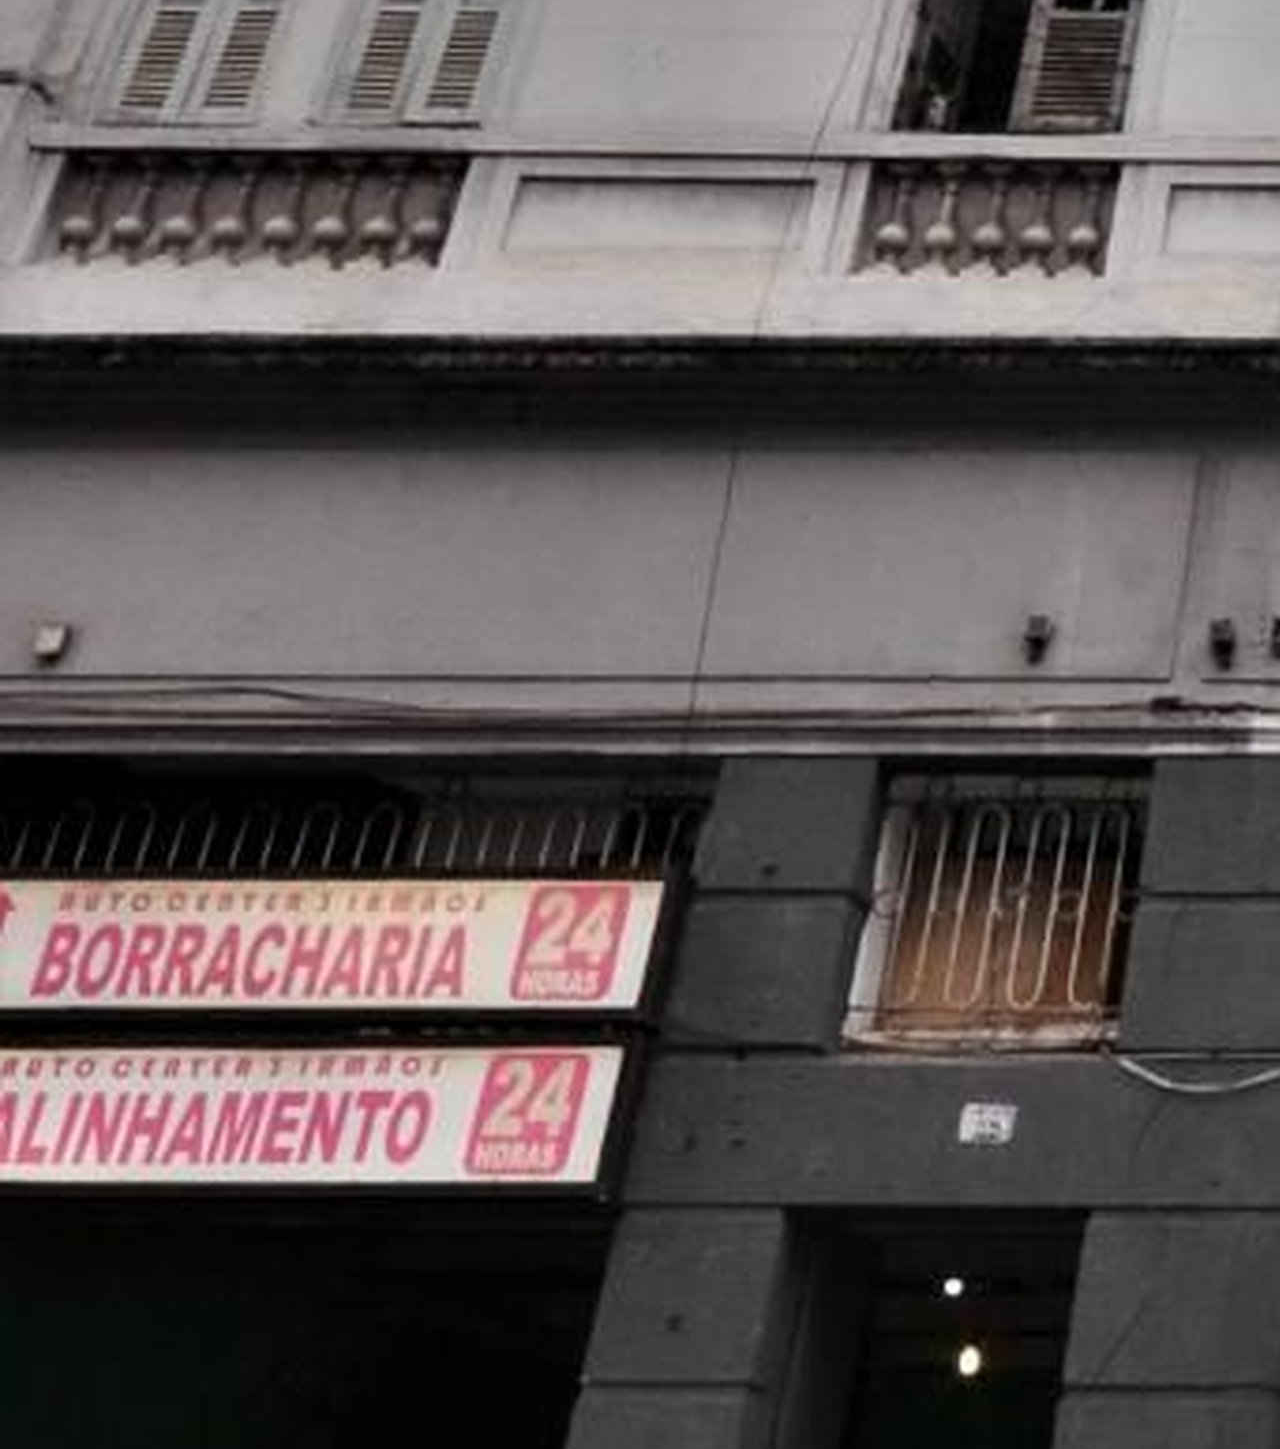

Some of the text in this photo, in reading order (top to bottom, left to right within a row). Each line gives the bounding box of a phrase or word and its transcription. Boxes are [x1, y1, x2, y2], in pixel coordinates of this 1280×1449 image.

[29, 922, 467, 998] BORRACHARIA
[524, 889, 617, 970] 24
[2, 1057, 95, 1079] AUTO
[481, 1057, 578, 1136] 24
